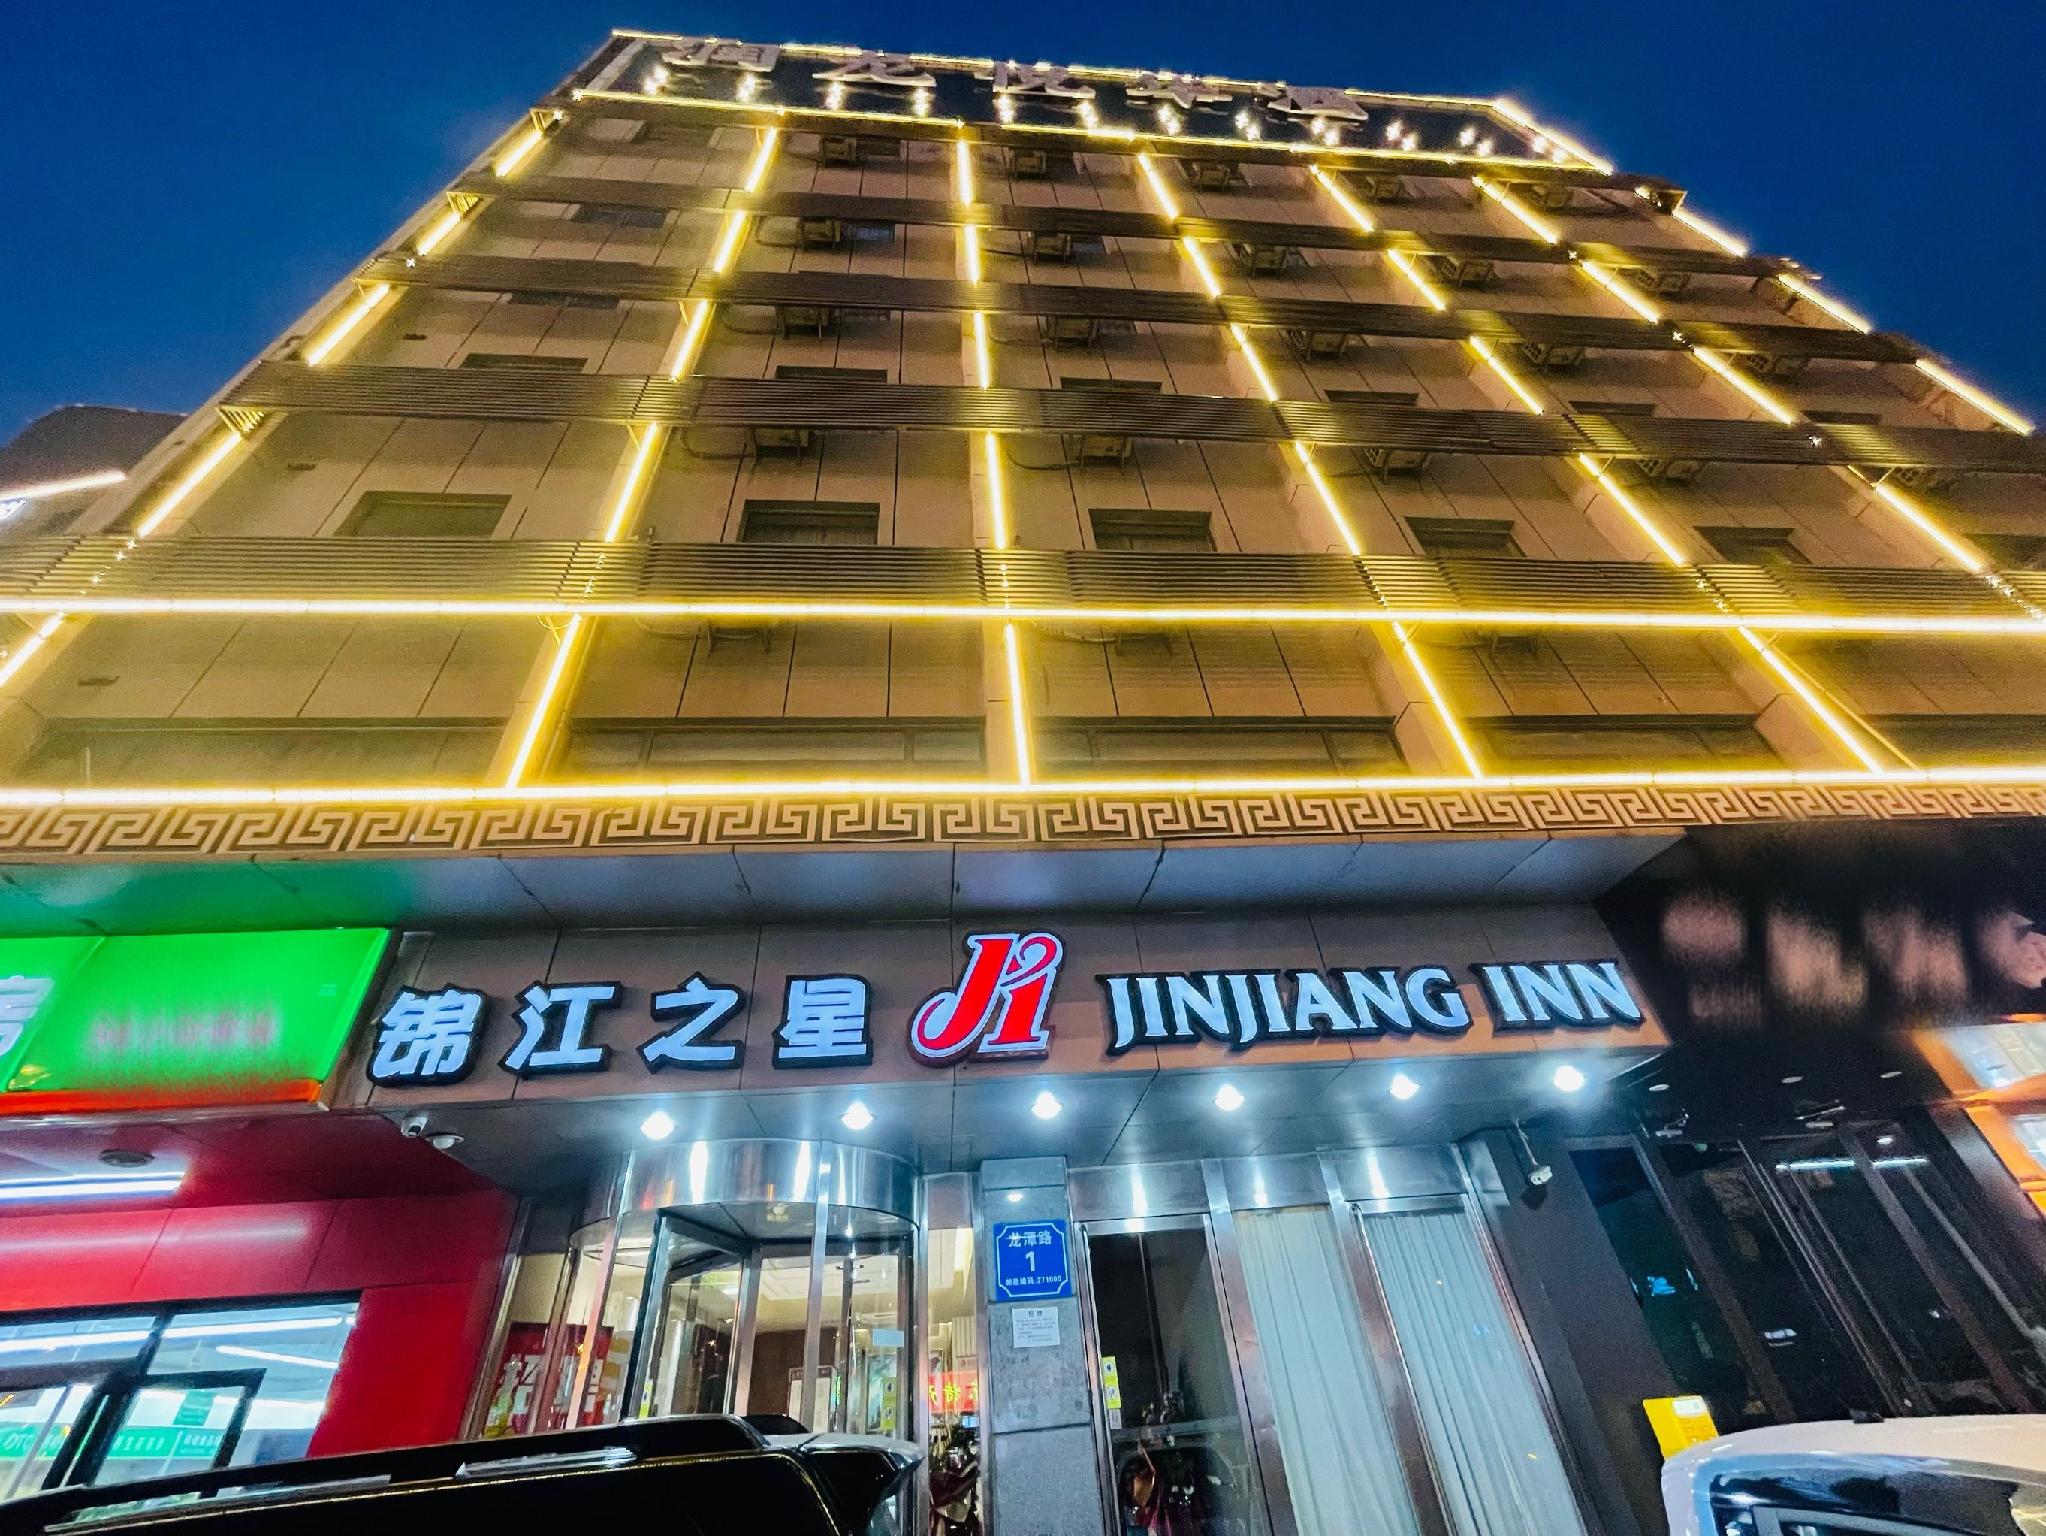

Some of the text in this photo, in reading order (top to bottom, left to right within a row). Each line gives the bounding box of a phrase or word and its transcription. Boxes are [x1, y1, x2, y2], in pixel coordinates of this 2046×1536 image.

[372, 974, 870, 1082] 锦江之星
[1100, 966, 1473, 1050] JINJIANG
[1477, 960, 1646, 1026] INN
[1025, 1250, 1036, 1272] 1
